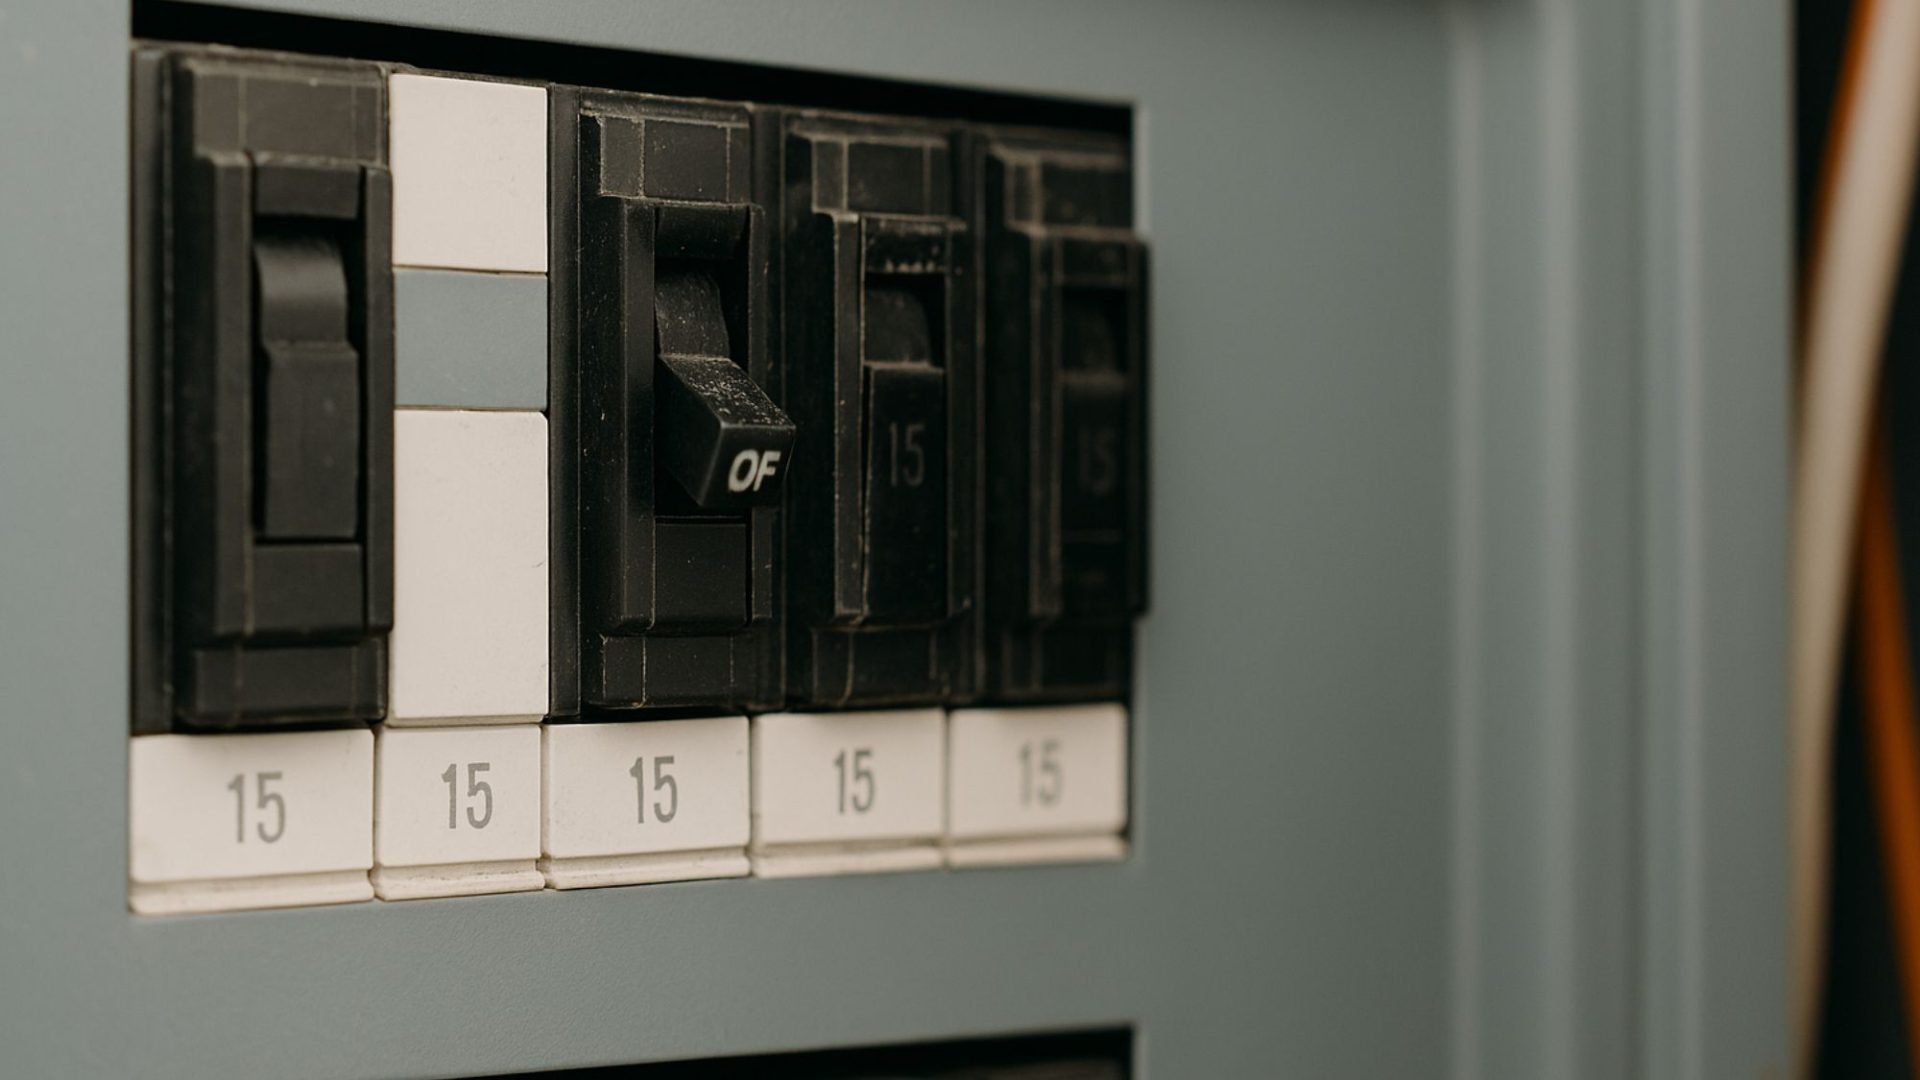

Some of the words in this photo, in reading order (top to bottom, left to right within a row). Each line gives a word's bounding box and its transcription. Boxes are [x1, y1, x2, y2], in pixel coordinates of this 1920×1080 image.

[728, 449, 781, 493] OF
[887, 421, 927, 487] 15
[441, 762, 494, 829] 15
[629, 755, 679, 824] 15
[833, 748, 876, 815] 15
[1017, 738, 1063, 807] 15
[227, 771, 287, 844] 15
